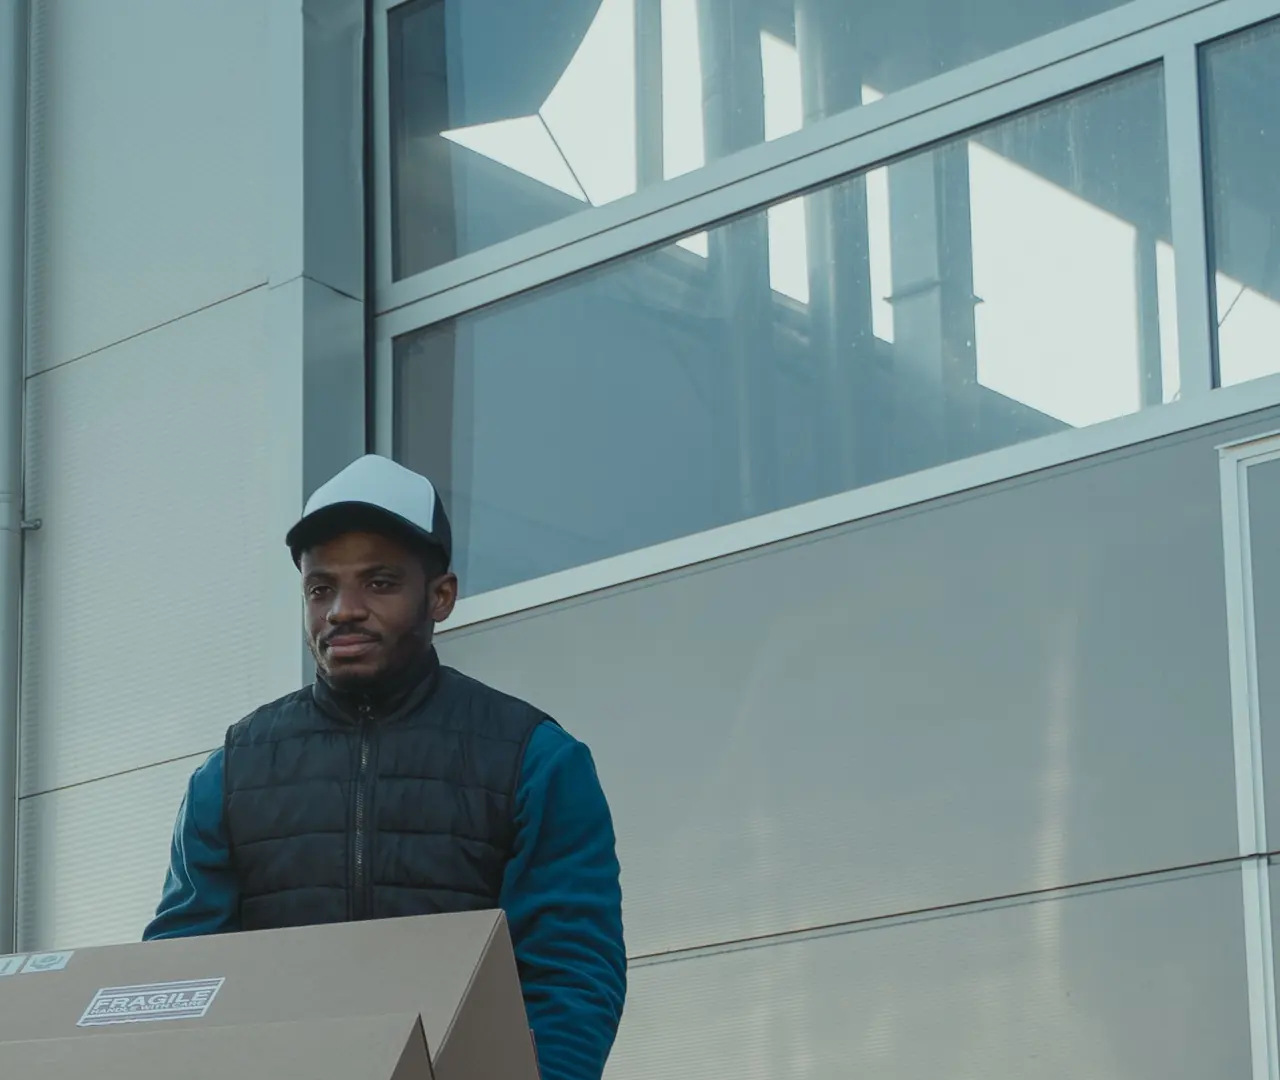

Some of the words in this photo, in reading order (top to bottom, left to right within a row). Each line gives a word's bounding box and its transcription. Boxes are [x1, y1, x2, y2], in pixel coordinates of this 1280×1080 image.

[90, 1006, 137, 1015] HANDLE
[171, 1000, 205, 1008] CARE
[93, 990, 212, 1010] FRAGILE
